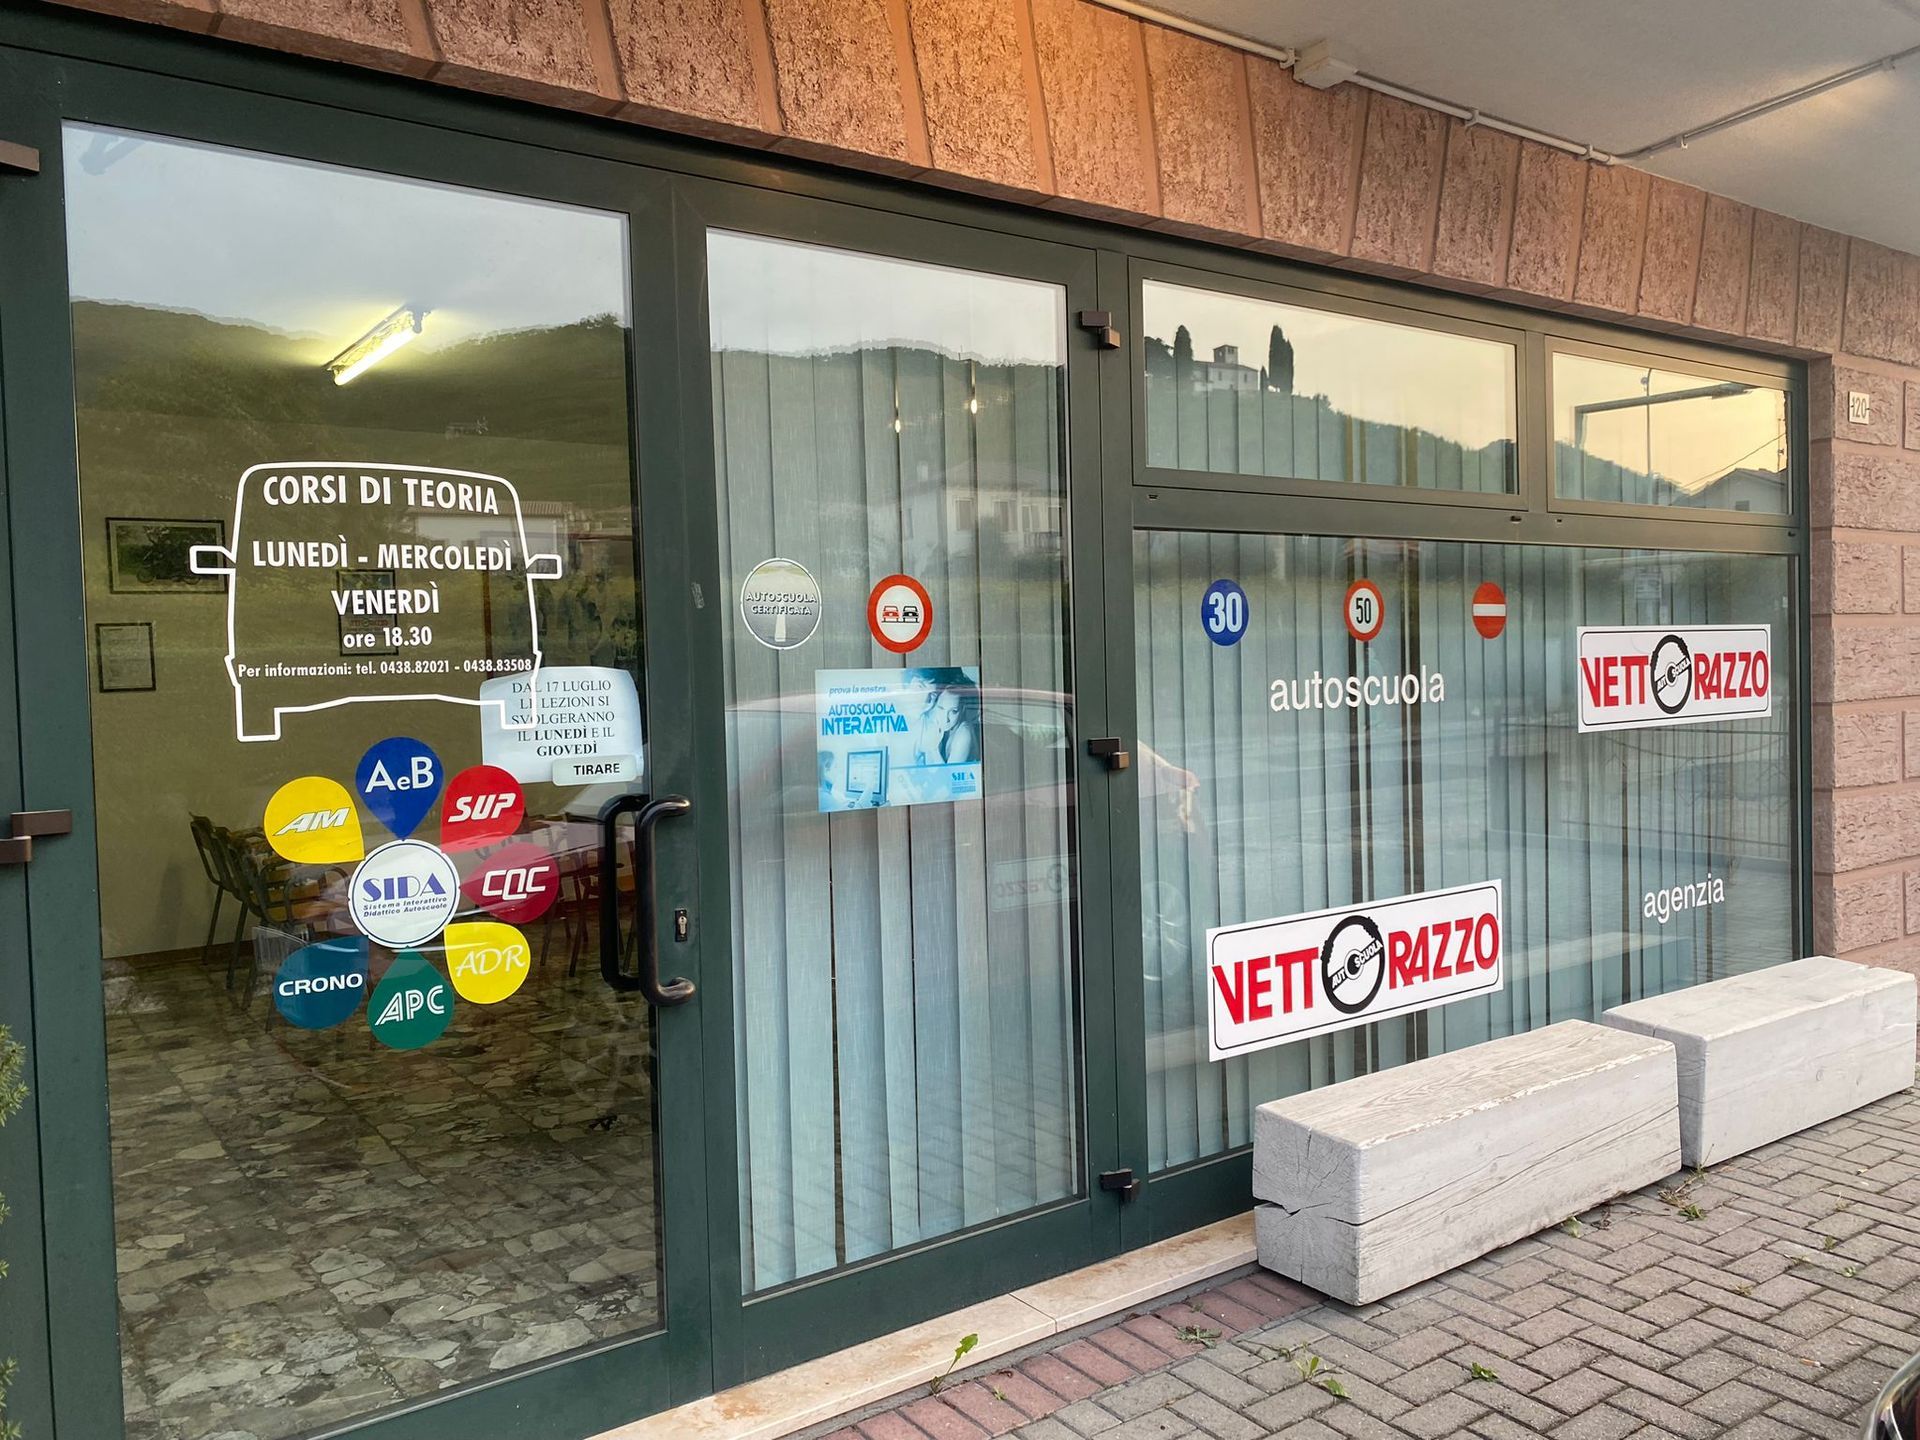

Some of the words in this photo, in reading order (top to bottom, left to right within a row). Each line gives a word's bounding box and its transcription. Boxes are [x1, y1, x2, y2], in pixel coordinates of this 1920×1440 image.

[1851, 397, 1867, 418] 120
[263, 475, 347, 505] CORSI
[359, 475, 391, 505] DI
[402, 477, 499, 515] TEORIA
[252, 534, 348, 568] LUNEDÌ
[377, 539, 512, 571] MERCOLEDÌ
[330, 580, 440, 615] VENERDÌ
[745, 591, 818, 604] AUTOSCUOLA
[751, 604, 813, 616] CERTIFICATA
[1208, 591, 1242, 634] 30
[1356, 597, 1372, 625] 50
[343, 633, 376, 648] ore
[383, 626, 433, 647] 18.30
[237, 663, 261, 677] Per
[264, 662, 352, 677] informazioni:
[355, 660, 377, 675] tel.
[380, 660, 450, 674] 0438.82021
[463, 658, 532, 672] 0438.83508
[546, 681, 559, 692] 17
[563, 680, 612, 692] LUGLIO
[829, 686, 851, 697] prova
[852, 684, 860, 693] la
[860, 685, 887, 693] nostra
[1269, 664, 1446, 712] autoscuola
[541, 696, 595, 709] LEZIONI
[598, 695, 609, 707] SI
[828, 702, 896, 716] AUTOSCUOLA
[517, 730, 531, 742] IL
[534, 725, 588, 741] LUNEDÌ
[591, 727, 600, 738] E
[603, 726, 615, 738] IL
[821, 715, 909, 736] INTERATTIVA
[536, 740, 598, 757] GIOVEDÌ
[364, 756, 435, 793] AeB
[573, 763, 621, 776] TIRARE
[447, 792, 517, 823] SUP
[272, 806, 350, 836] AM
[362, 872, 447, 902] SIDA
[481, 865, 550, 901] CQC
[363, 902, 400, 911] Sistema
[403, 896, 447, 906] Interattivo
[1643, 873, 1725, 924] agenzia
[363, 909, 400, 917] Didattico
[456, 944, 527, 978] ADR
[278, 973, 363, 997] CRONO
[374, 984, 445, 1026] APC
